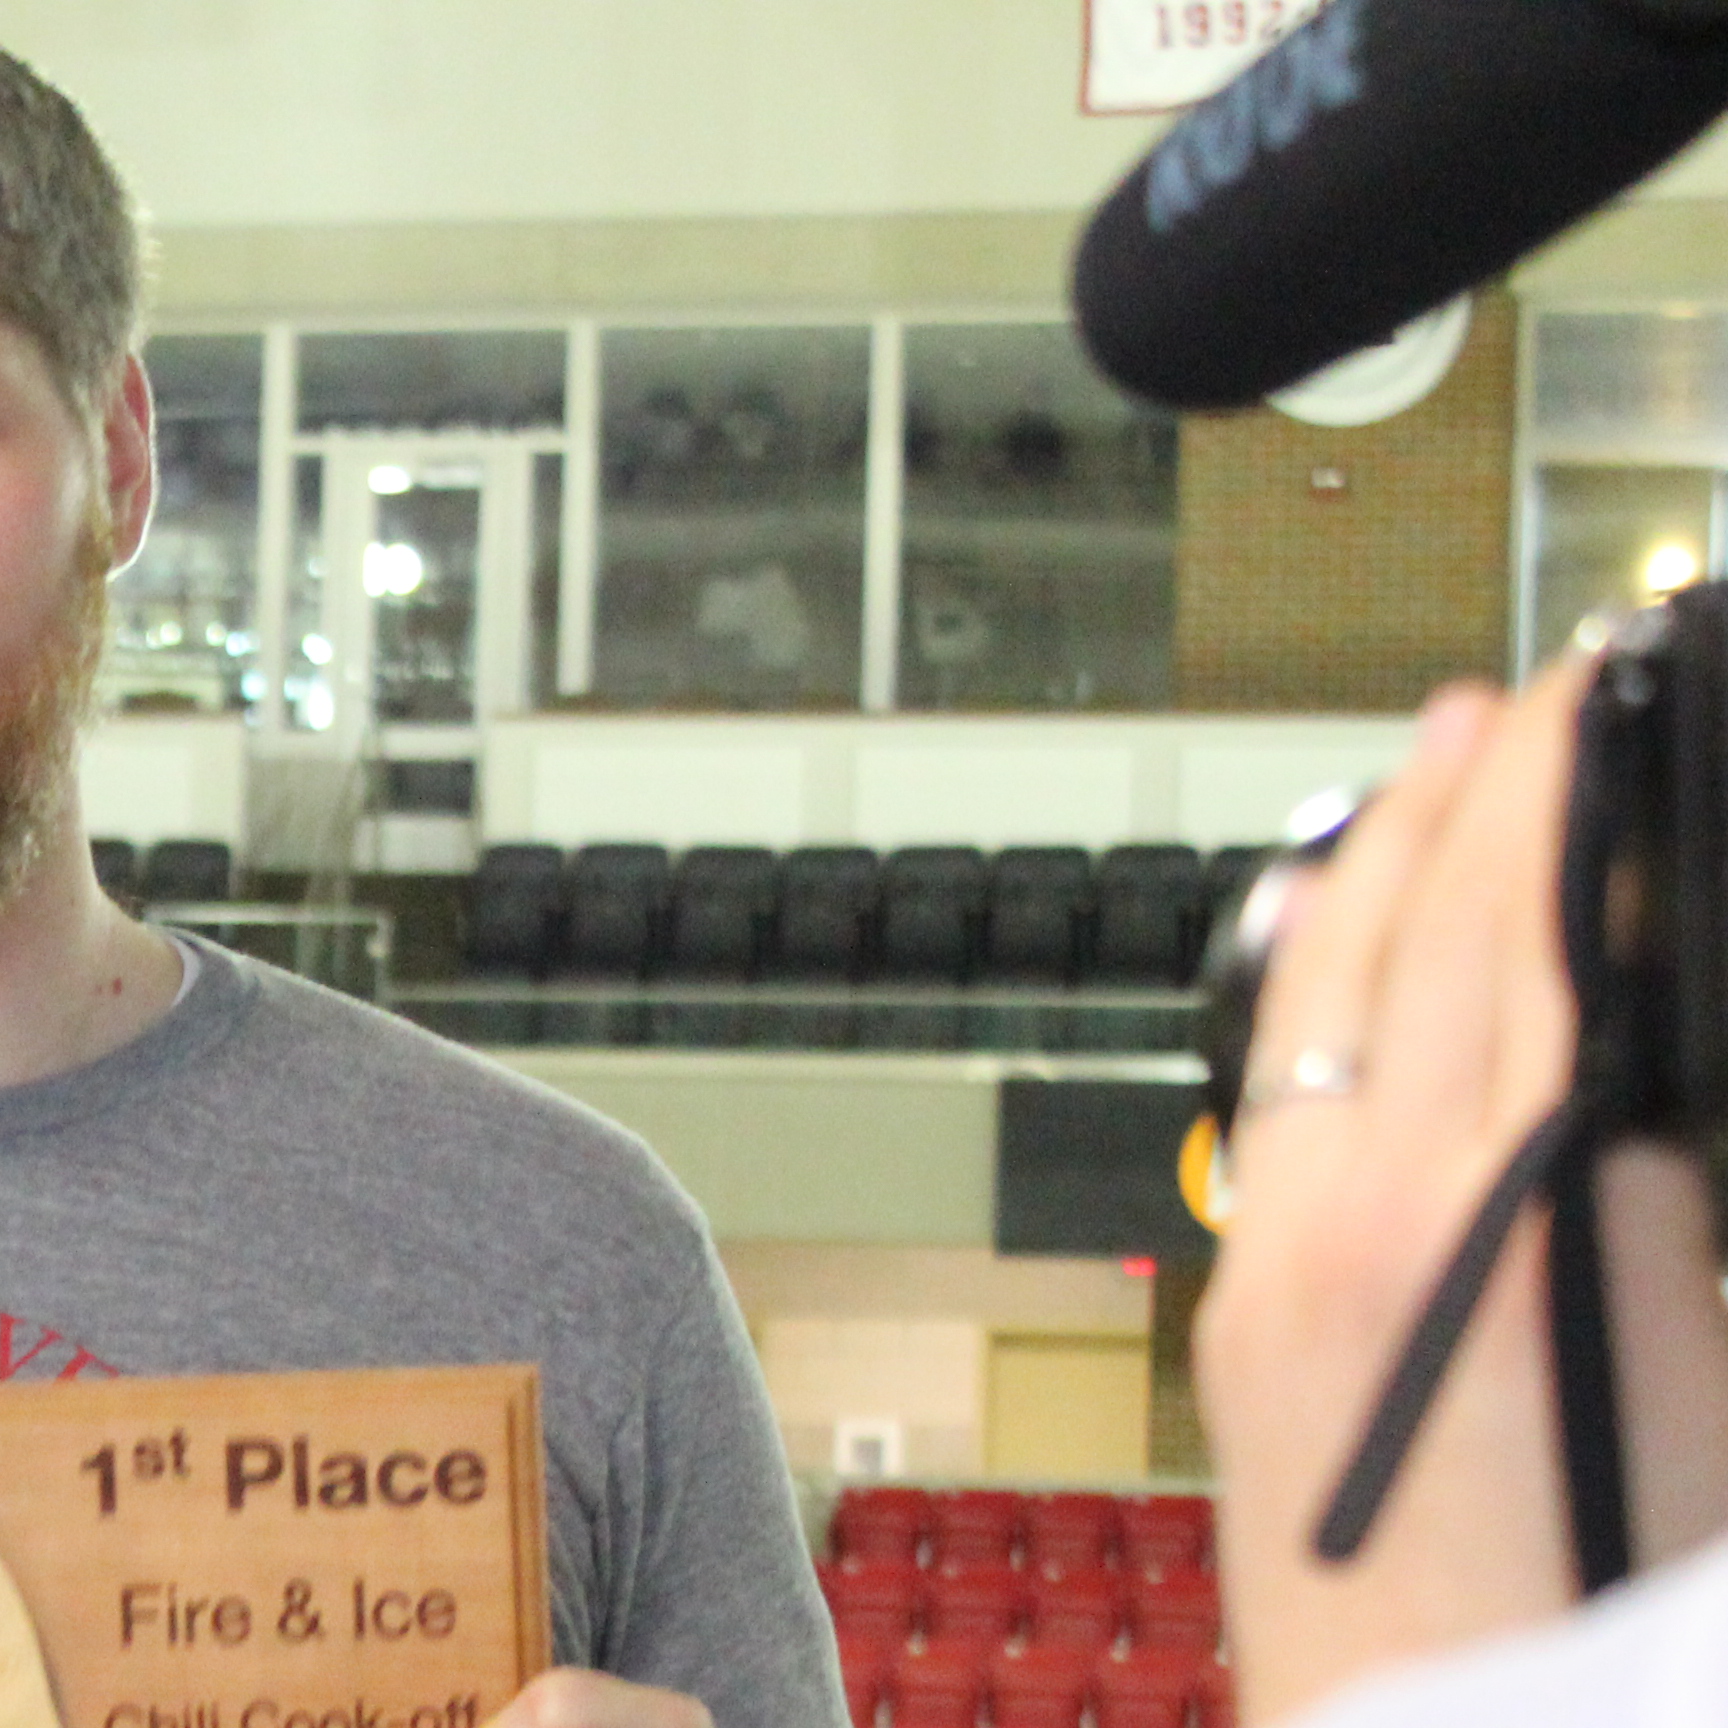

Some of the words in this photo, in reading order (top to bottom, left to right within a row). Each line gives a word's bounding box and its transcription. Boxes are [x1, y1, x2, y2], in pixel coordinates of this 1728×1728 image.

[81, 1427, 192, 1518] 1st
[224, 1434, 488, 1512] Place
[119, 1580, 253, 1650] Fire
[276, 1578, 325, 1644] &
[354, 1578, 459, 1641] Ice
